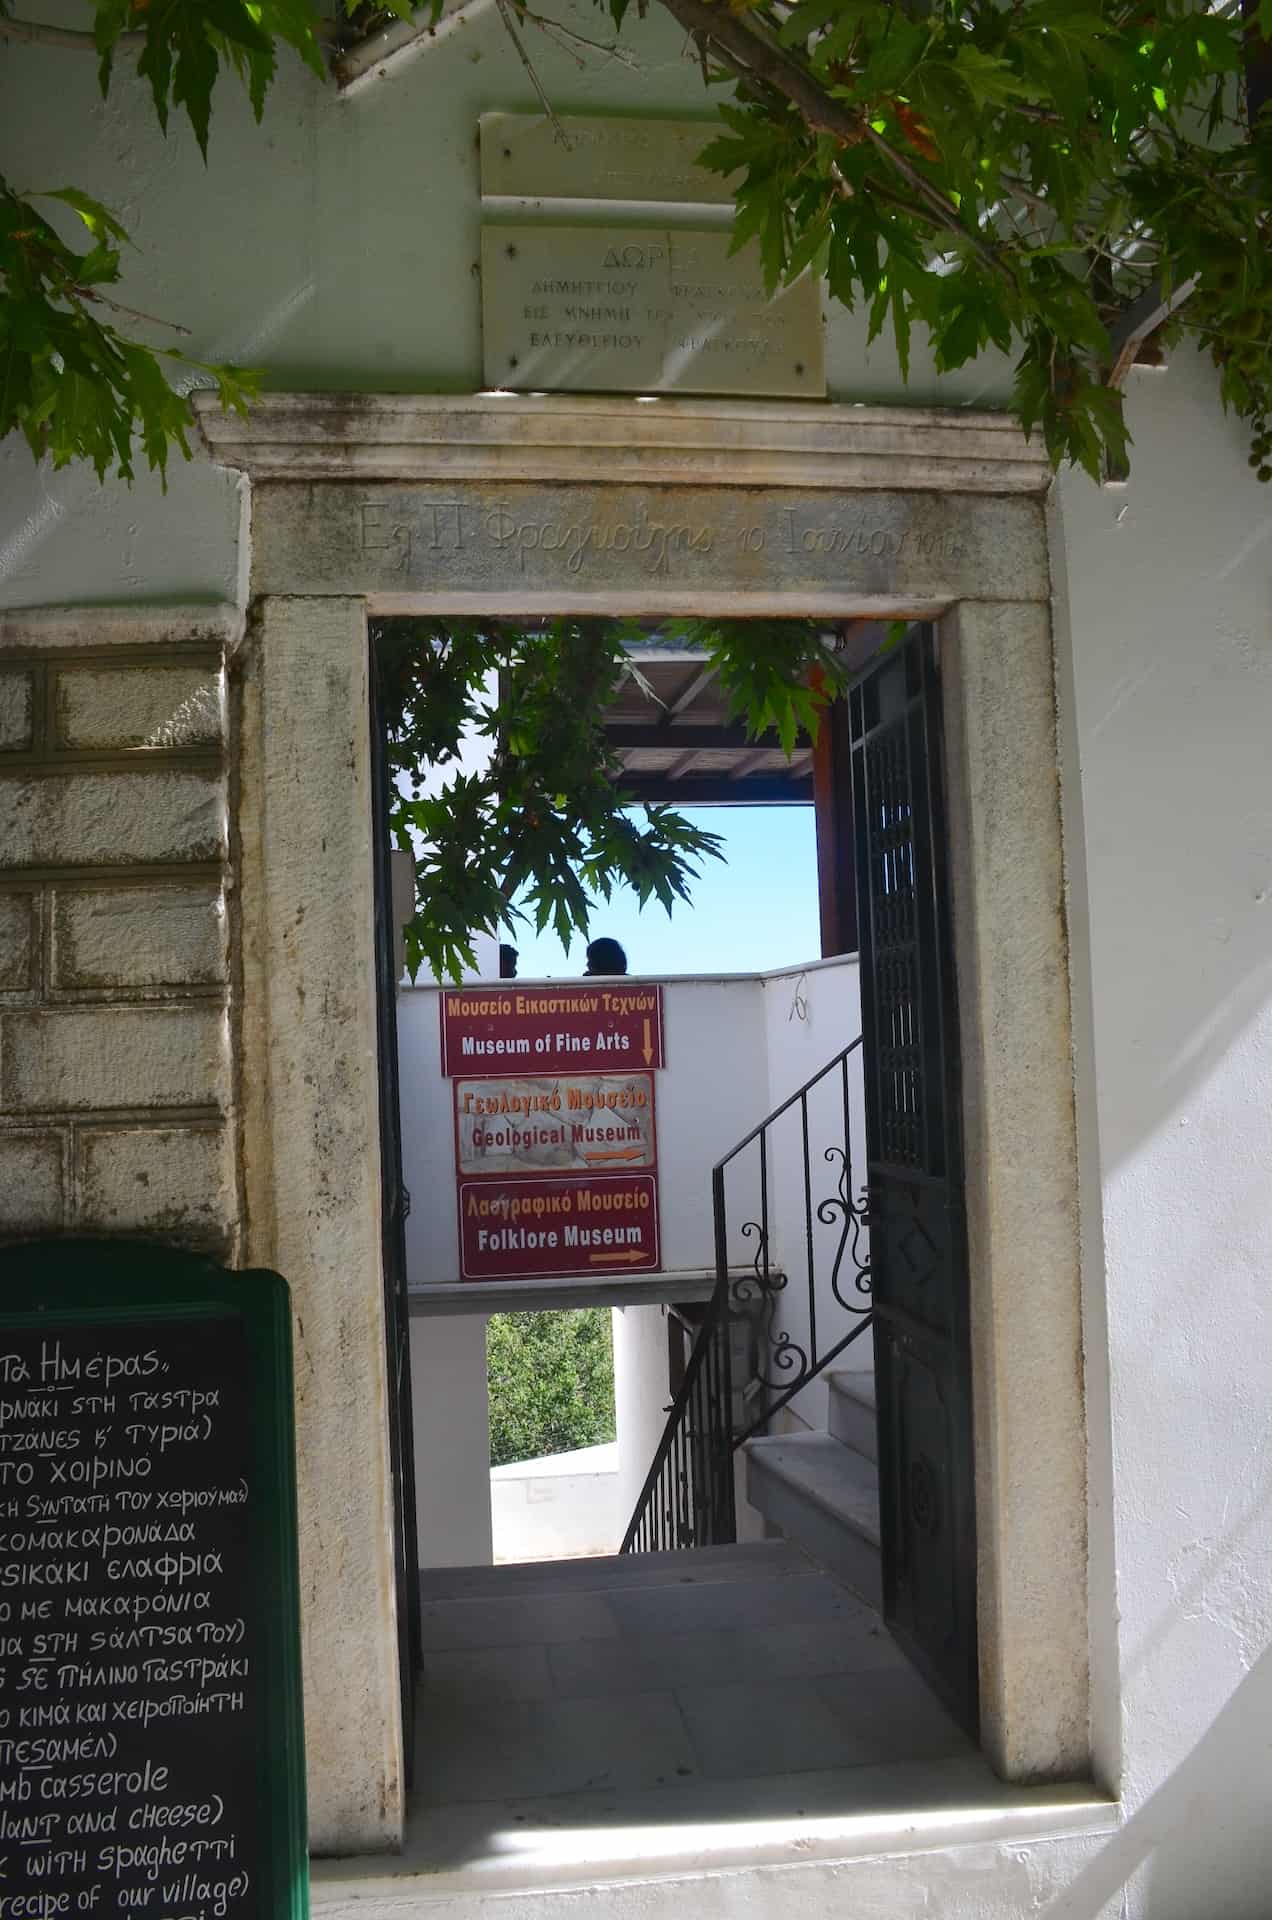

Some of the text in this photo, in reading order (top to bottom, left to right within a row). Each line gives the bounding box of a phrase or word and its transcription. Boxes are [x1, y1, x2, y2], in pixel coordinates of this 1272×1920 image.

[448, 992, 656, 1017] Μουσείο Εικαστικών Τεχνών
[462, 1033, 630, 1055] Museum of Fine Arts
[463, 1085, 648, 1119] Γεωλογικό Μουσείο
[472, 1126, 641, 1149] Geological Museum
[576, 1187, 650, 1212] Μουσείο
[478, 1225, 642, 1251] Folklore Museum
[77, 1884, 102, 1909] of
[117, 1887, 156, 1908] our
